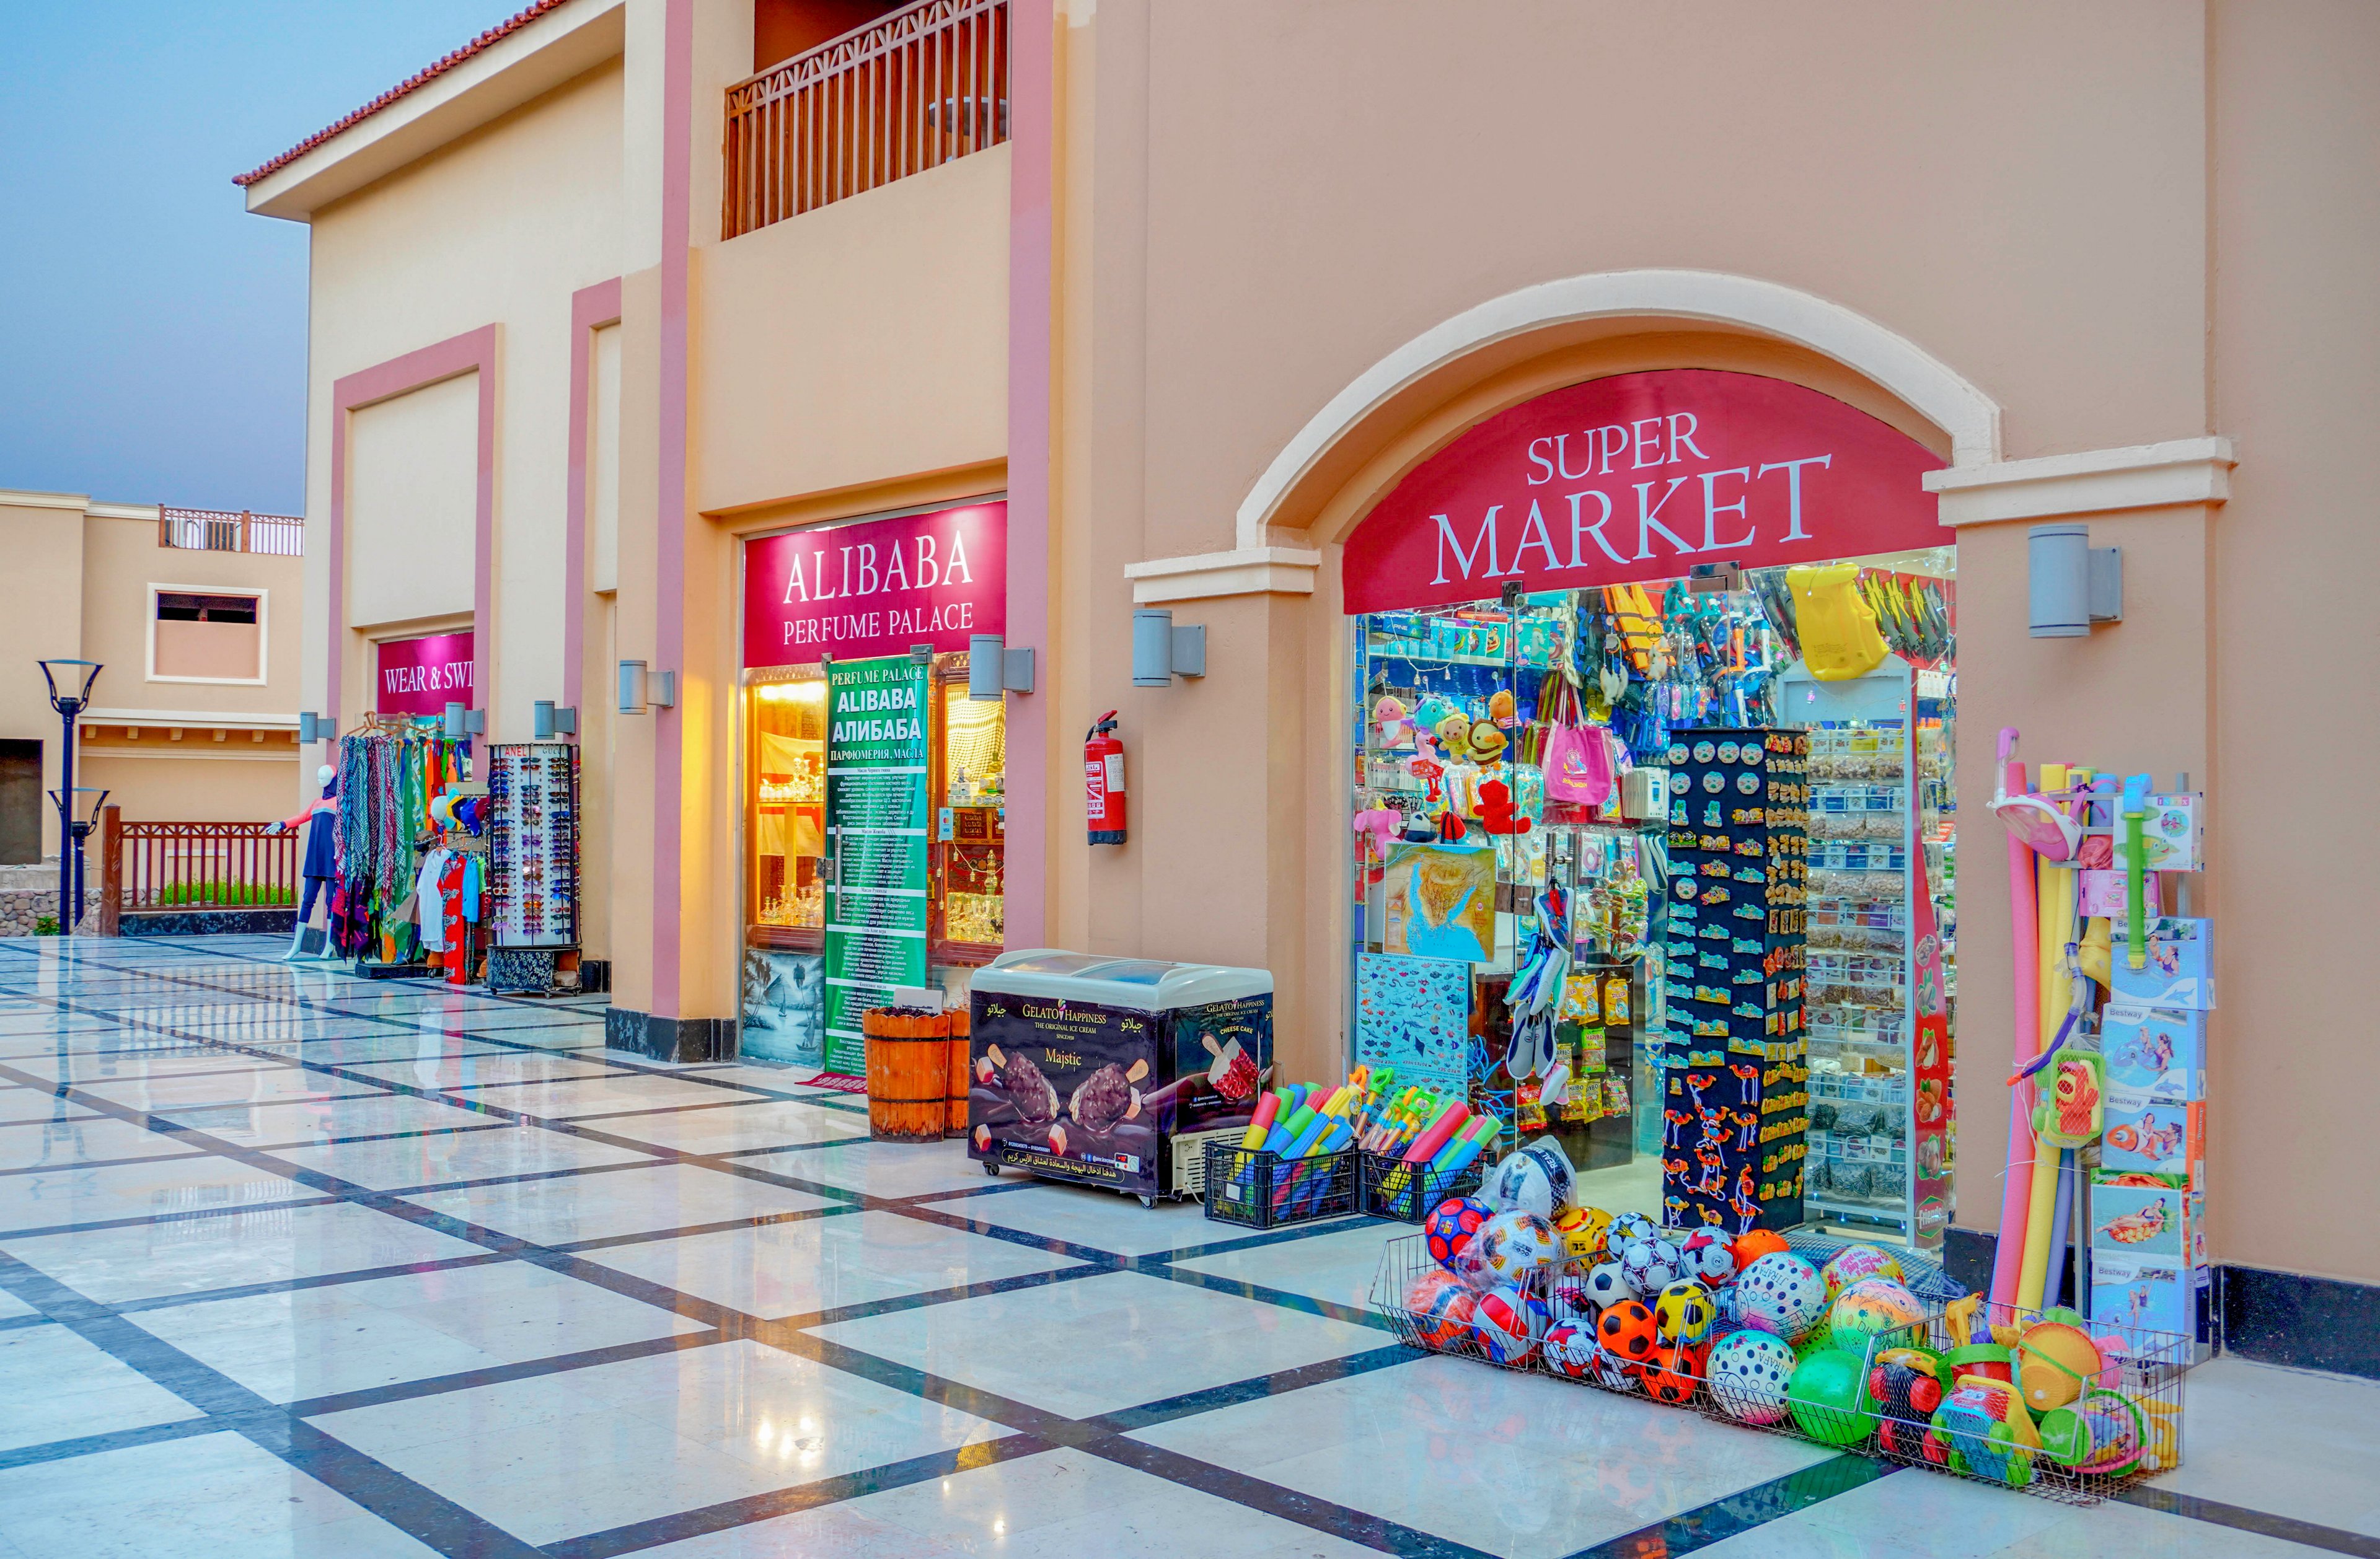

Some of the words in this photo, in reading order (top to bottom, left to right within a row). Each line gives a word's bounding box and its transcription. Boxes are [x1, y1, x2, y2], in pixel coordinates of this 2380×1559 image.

[1526, 411, 1709, 486] SUPER
[1429, 454, 1832, 586] MARKET
[782, 530, 973, 604] ALIBABA
[783, 612, 880, 645] PERFUME
[888, 602, 973, 636] PALACE
[385, 665, 428, 694] WEAR
[430, 666, 441, 690] &
[444, 661, 474, 689] SWI
[832, 670, 879, 686] PERFUME
[883, 666, 923, 683] PALACE
[837, 687, 917, 713] ALIBABA
[832, 718, 922, 743] АЛИБАБА
[505, 747, 527, 757] ANEL
[893, 748, 923, 759] МАСЛА
[986, 1003, 1007, 1017] جيلاتو
[1023, 1004, 1059, 1019] GELATO
[1065, 1010, 1106, 1024] HAPPINESS
[2110, 1008, 2143, 1019] Bestway
[1045, 1023, 1069, 1031] ORIGINAL
[1078, 1026, 1096, 1034] CREAM
[1121, 1018, 1144, 1033] جيلاتو
[1220, 1025, 1239, 1035] CHEESE
[1240, 1025, 1253, 1034] CAKE
[1045, 1048, 1082, 1069] Majstic
[2109, 1096, 2141, 1107] Bestway
[1007, 1152, 1019, 1162] كريم
[1033, 1156, 1048, 1165] لعشاق
[1049, 1158, 1070, 1171] والسعادة
[1542, 1151, 1558, 1169] REAL
[1071, 1162, 1086, 1174] البهجة
[1087, 1165, 1101, 1175] ادخال
[1102, 1168, 1116, 1177] هدفنا
[1919, 1205, 1942, 1229] Friends
[1759, 1267, 1789, 1286] JIRAFA
[2098, 1267, 2131, 1278] Bestway
[1759, 1352, 1790, 1377] JIRAFA
